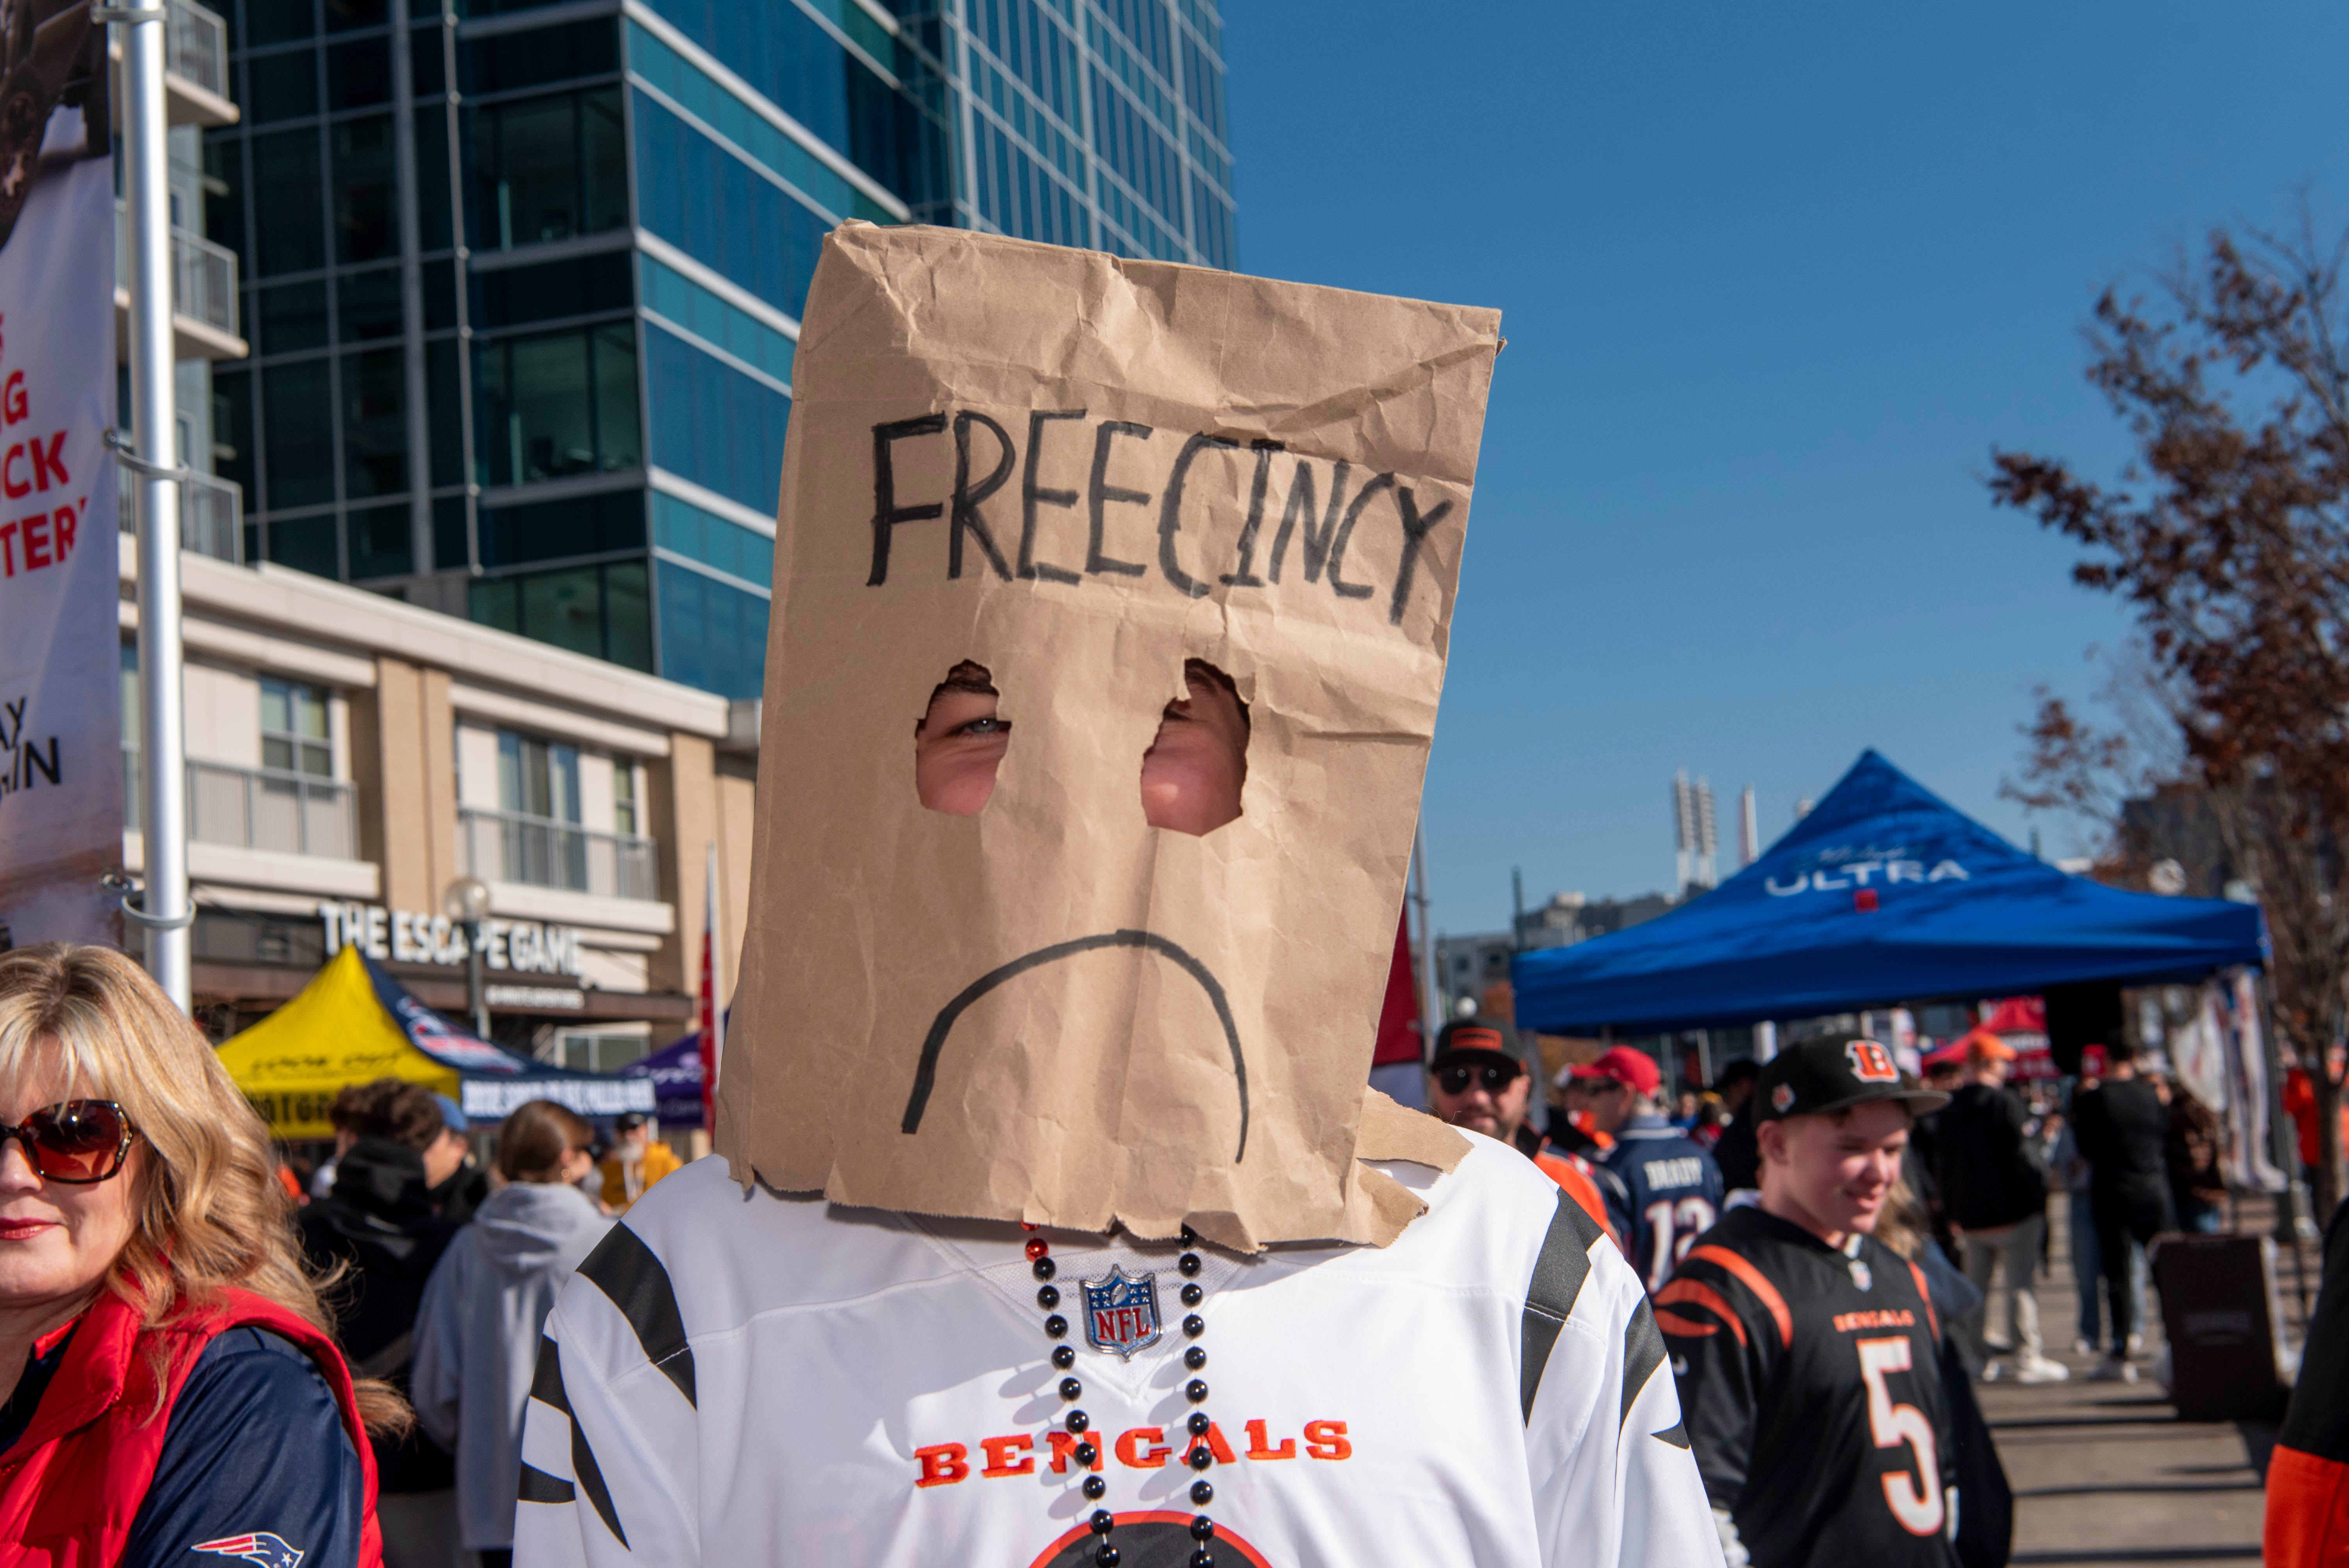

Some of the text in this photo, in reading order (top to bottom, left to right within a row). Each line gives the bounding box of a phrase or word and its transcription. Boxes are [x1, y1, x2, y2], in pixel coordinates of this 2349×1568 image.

[1764, 859, 1969, 897] ULTRA
[318, 901, 389, 960] THE
[509, 921, 584, 976] GAME
[1643, 1156, 1703, 1191] BRADY
[1096, 1308, 1150, 1344] NFL
[1833, 1309, 1916, 1333] BENGALS
[914, 1419, 1352, 1489] BENGALS
[1856, 1336, 1946, 1538] 5
